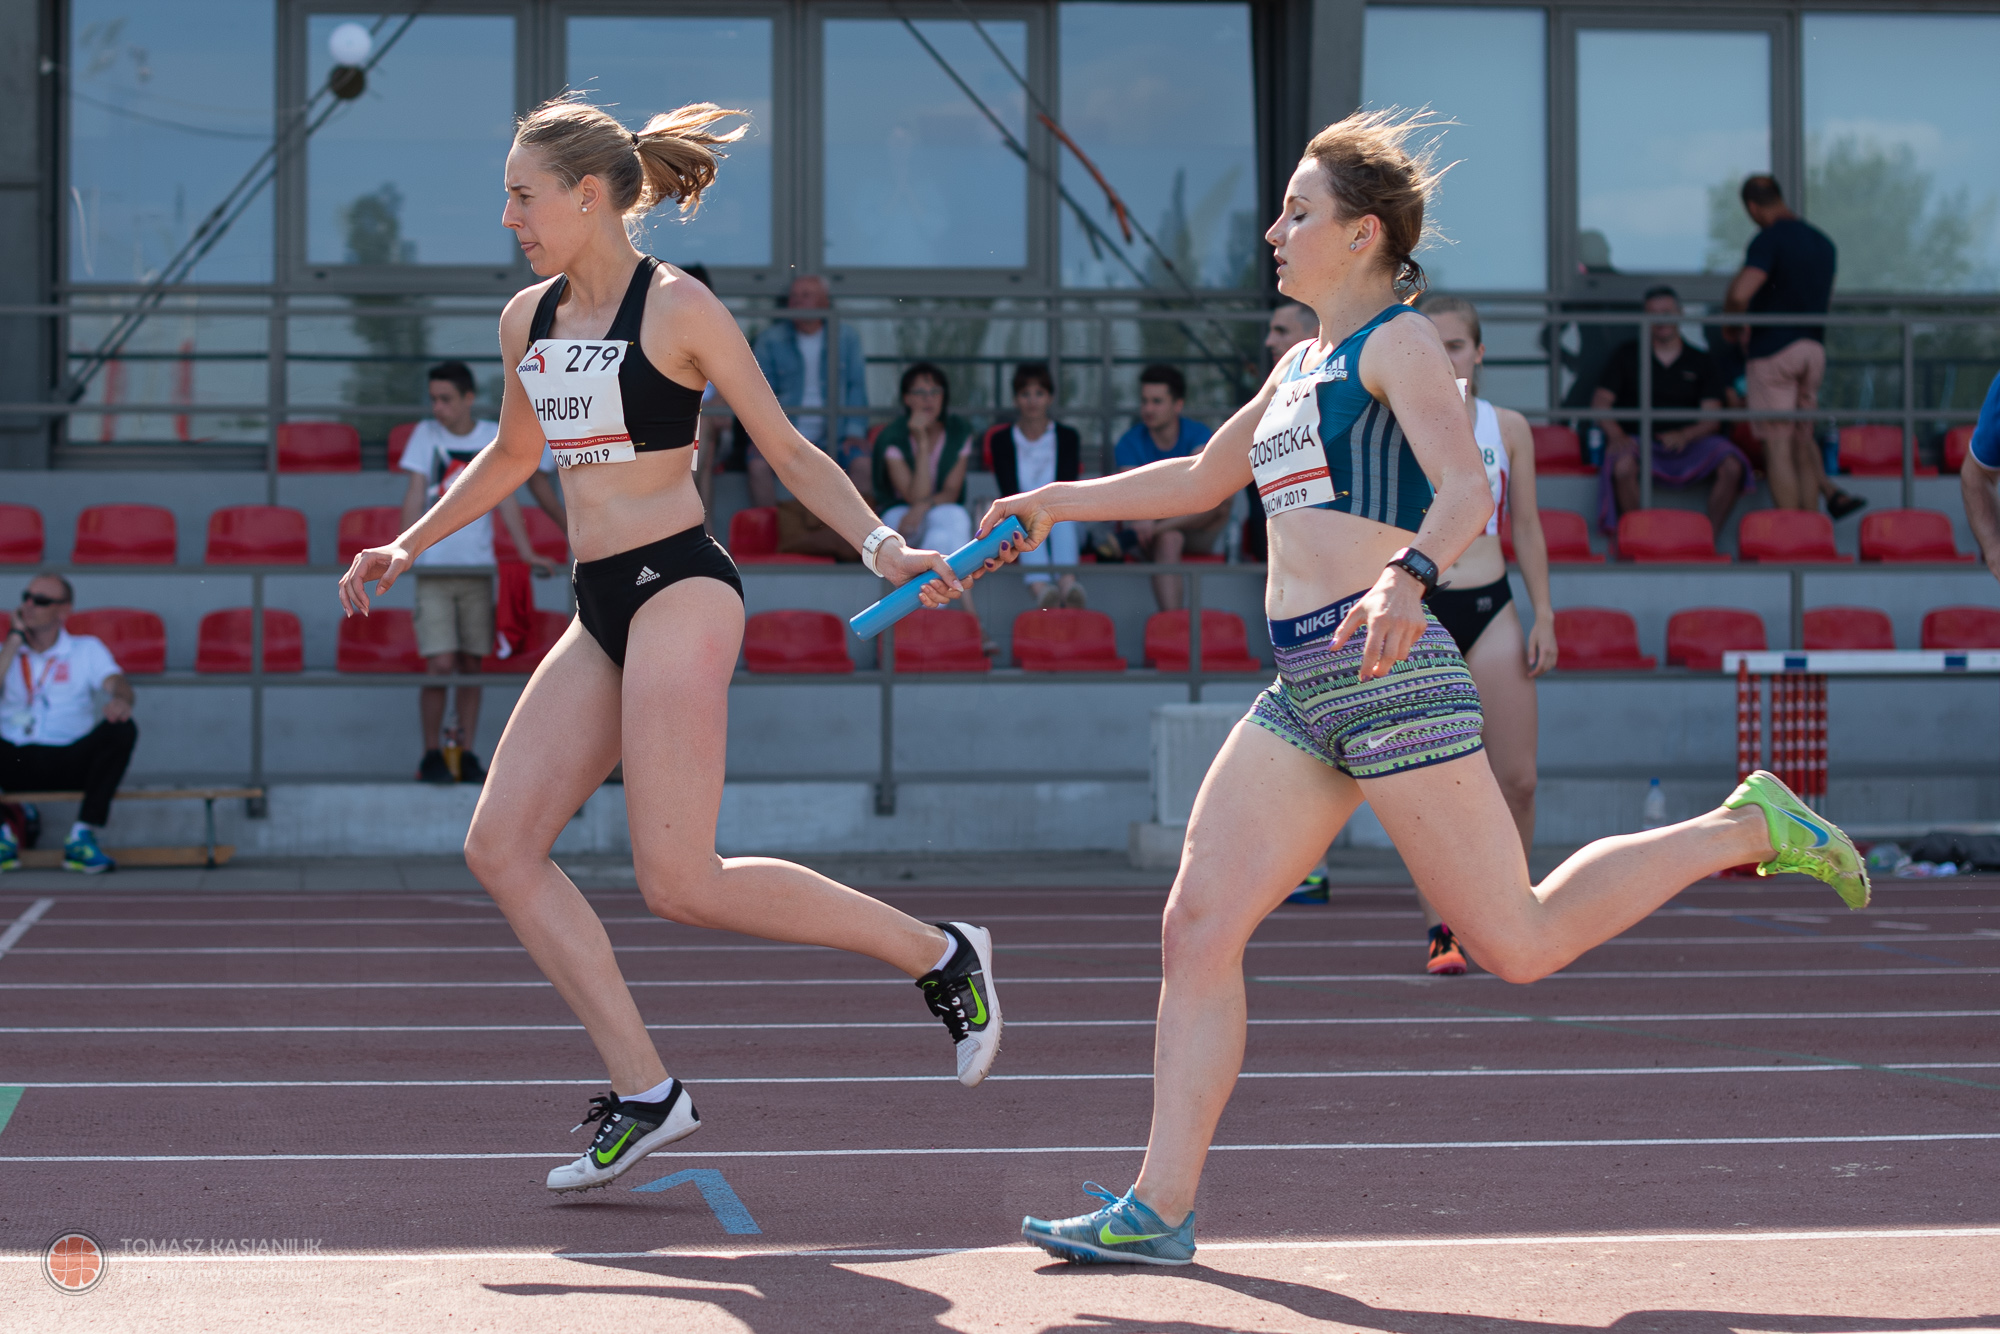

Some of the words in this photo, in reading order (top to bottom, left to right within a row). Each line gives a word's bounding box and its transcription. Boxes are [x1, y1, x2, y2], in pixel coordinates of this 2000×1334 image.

[518, 363, 539, 374] polanik
[565, 345, 619, 373] 279
[535, 396, 593, 421] HRUBY
[575, 448, 610, 465] 2019
[1250, 424, 1316, 469] ZOSTECKA
[1262, 493, 1283, 514] AKÓW
[1284, 488, 1308, 507] 2019
[635, 572, 661, 586] adidas
[1295, 608, 1336, 637] NIKE
